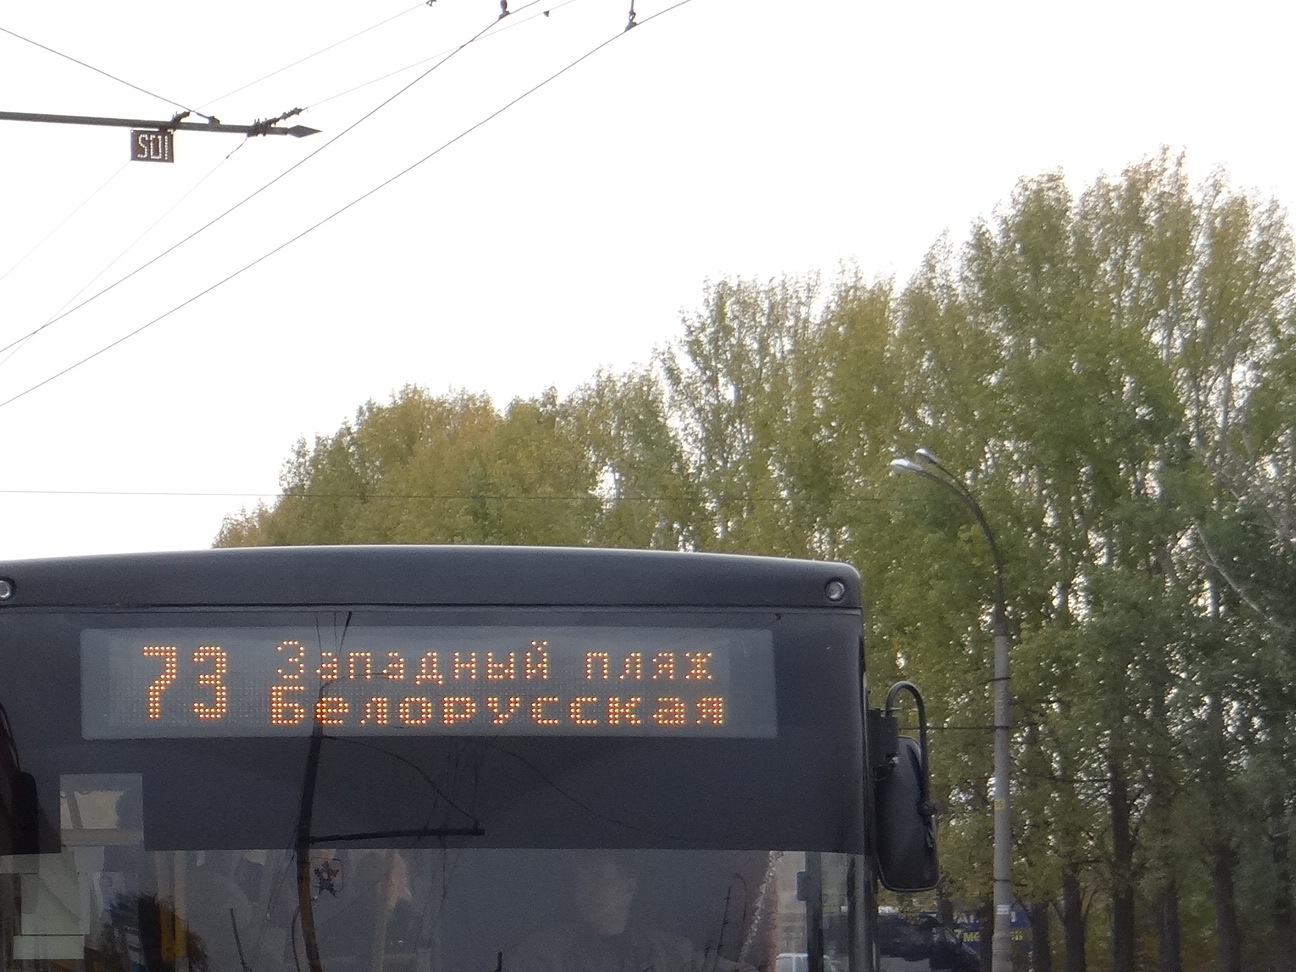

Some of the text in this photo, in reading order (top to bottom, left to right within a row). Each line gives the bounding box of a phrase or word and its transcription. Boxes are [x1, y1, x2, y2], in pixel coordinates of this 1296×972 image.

[141, 645, 228, 721] 73
[275, 639, 715, 686] Западный пляж
[268, 685, 725, 726] Белорусская
